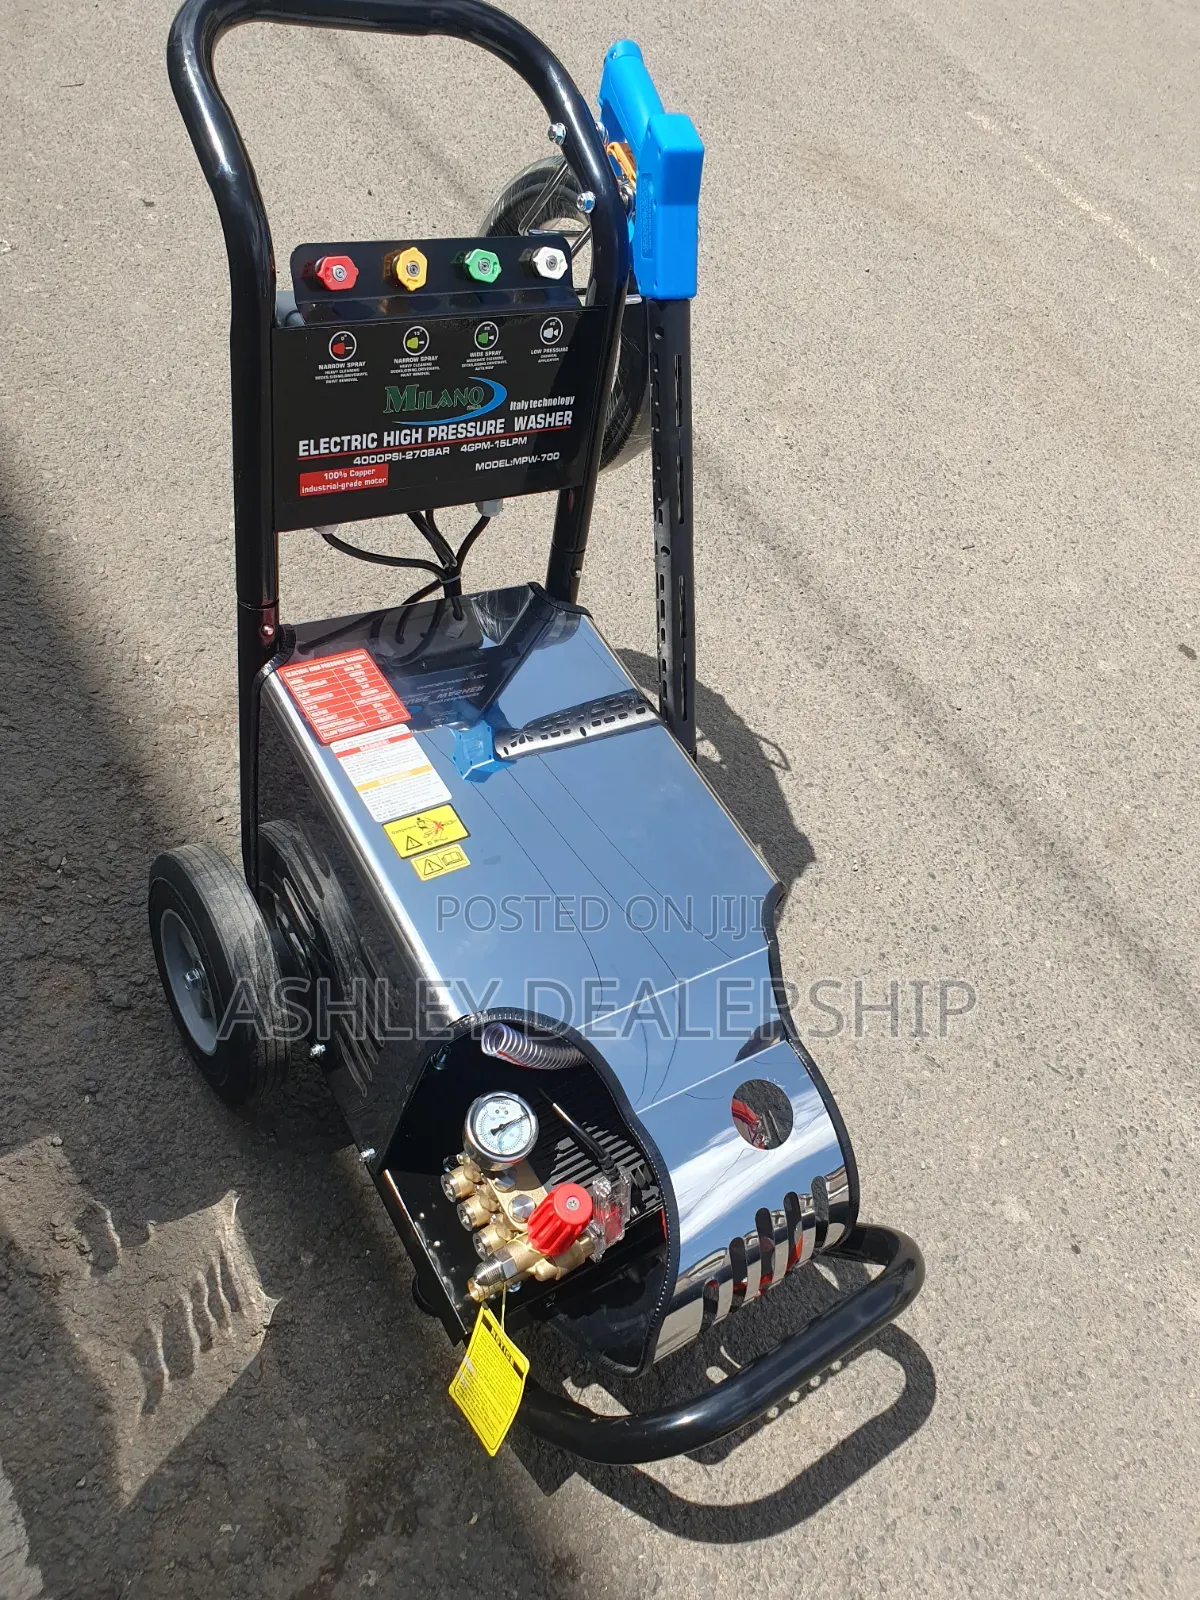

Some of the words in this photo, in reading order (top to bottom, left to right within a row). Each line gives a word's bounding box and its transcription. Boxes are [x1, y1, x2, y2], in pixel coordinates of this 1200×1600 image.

[510, 400, 529, 411] Italy
[530, 396, 575, 408] technology
[298, 433, 377, 456] ELECTRIC
[384, 428, 422, 447] HIGH
[428, 419, 505, 442] PRESSURE
[514, 411, 572, 431] WASHER
[353, 447, 450, 465] 4000PSI-270BAR
[460, 436, 528, 452] 4GPM-15LPM
[475, 452, 560, 471] MODEL:MPW-700
[324, 471, 347, 480] 100%
[350, 469, 375, 477] Copper
[364, 477, 386, 486] motor
